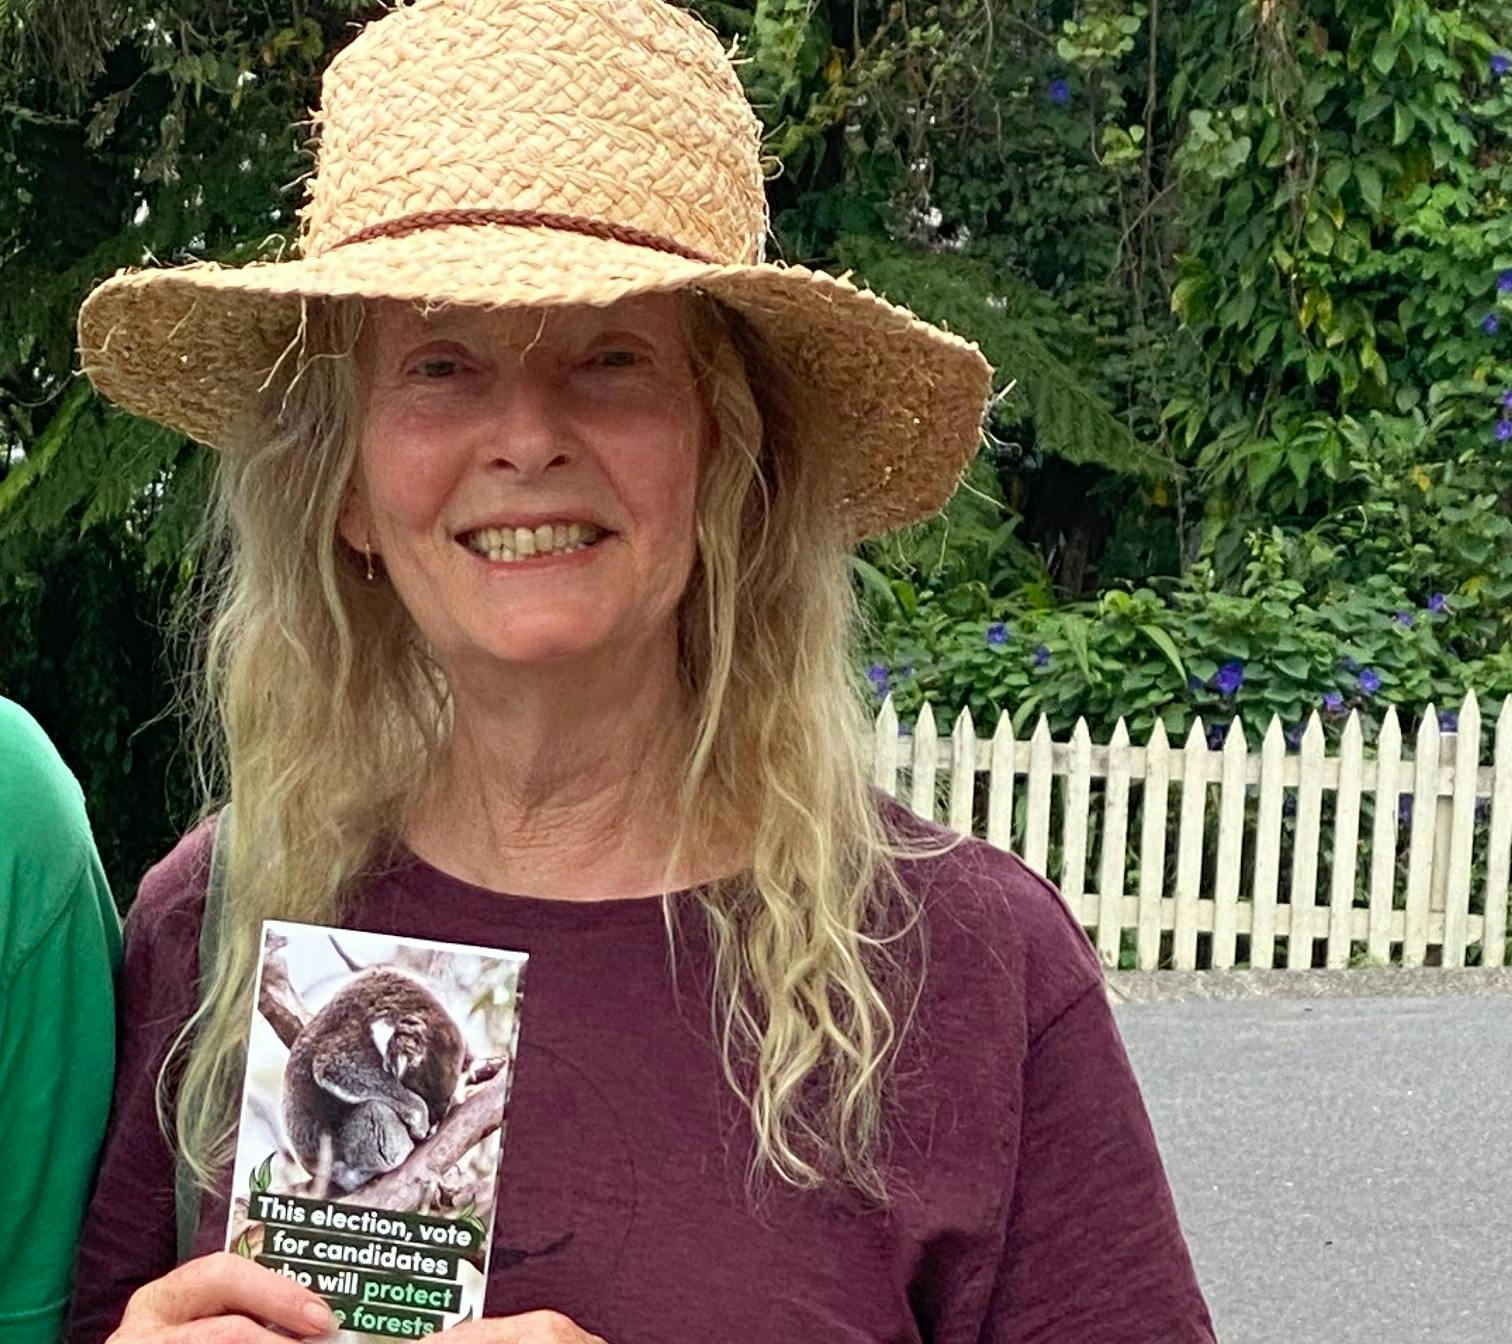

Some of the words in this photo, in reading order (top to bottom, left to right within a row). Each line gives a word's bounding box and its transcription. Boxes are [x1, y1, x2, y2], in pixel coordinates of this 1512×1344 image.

[257, 1196, 305, 1223] This
[311, 1205, 413, 1242] election,
[419, 1223, 472, 1246] vote
[273, 1230, 310, 1255] for
[313, 1242, 448, 1275] candidates
[318, 1271, 358, 1295] will
[363, 1281, 453, 1307] protect
[352, 1305, 435, 1336] forests
